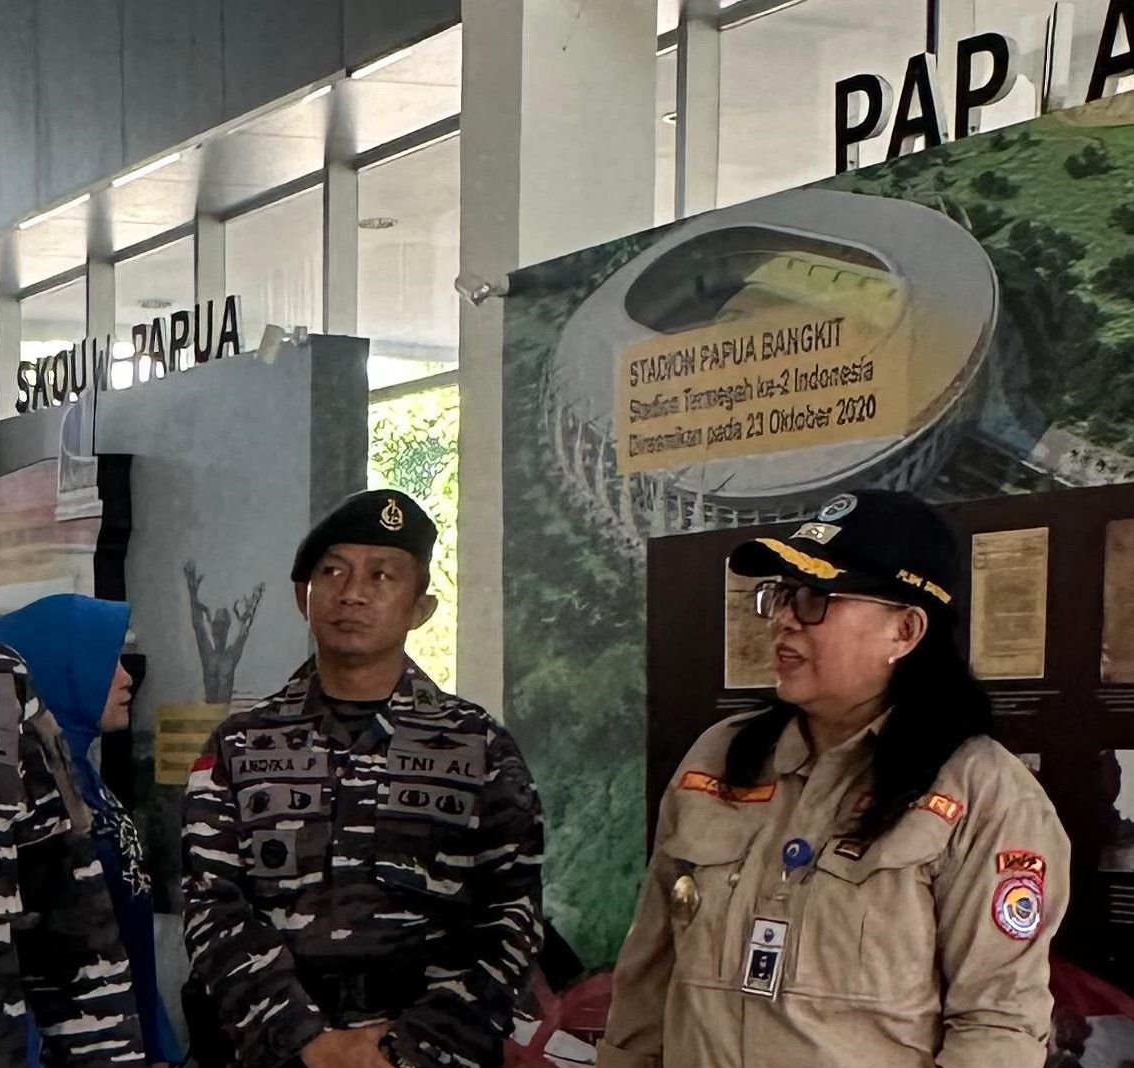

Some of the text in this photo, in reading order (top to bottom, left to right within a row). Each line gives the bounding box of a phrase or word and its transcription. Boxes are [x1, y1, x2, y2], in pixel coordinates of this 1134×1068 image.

[132, 294, 242, 379] PAPUA
[630, 317, 845, 387] STADION PAPUA BANGKIT
[794, 355, 874, 393] Indonesia
[746, 410, 764, 439] 23
[769, 404, 834, 435] Oktober
[836, 394, 877, 426] 2020
[397, 755, 476, 778] TNI AL
